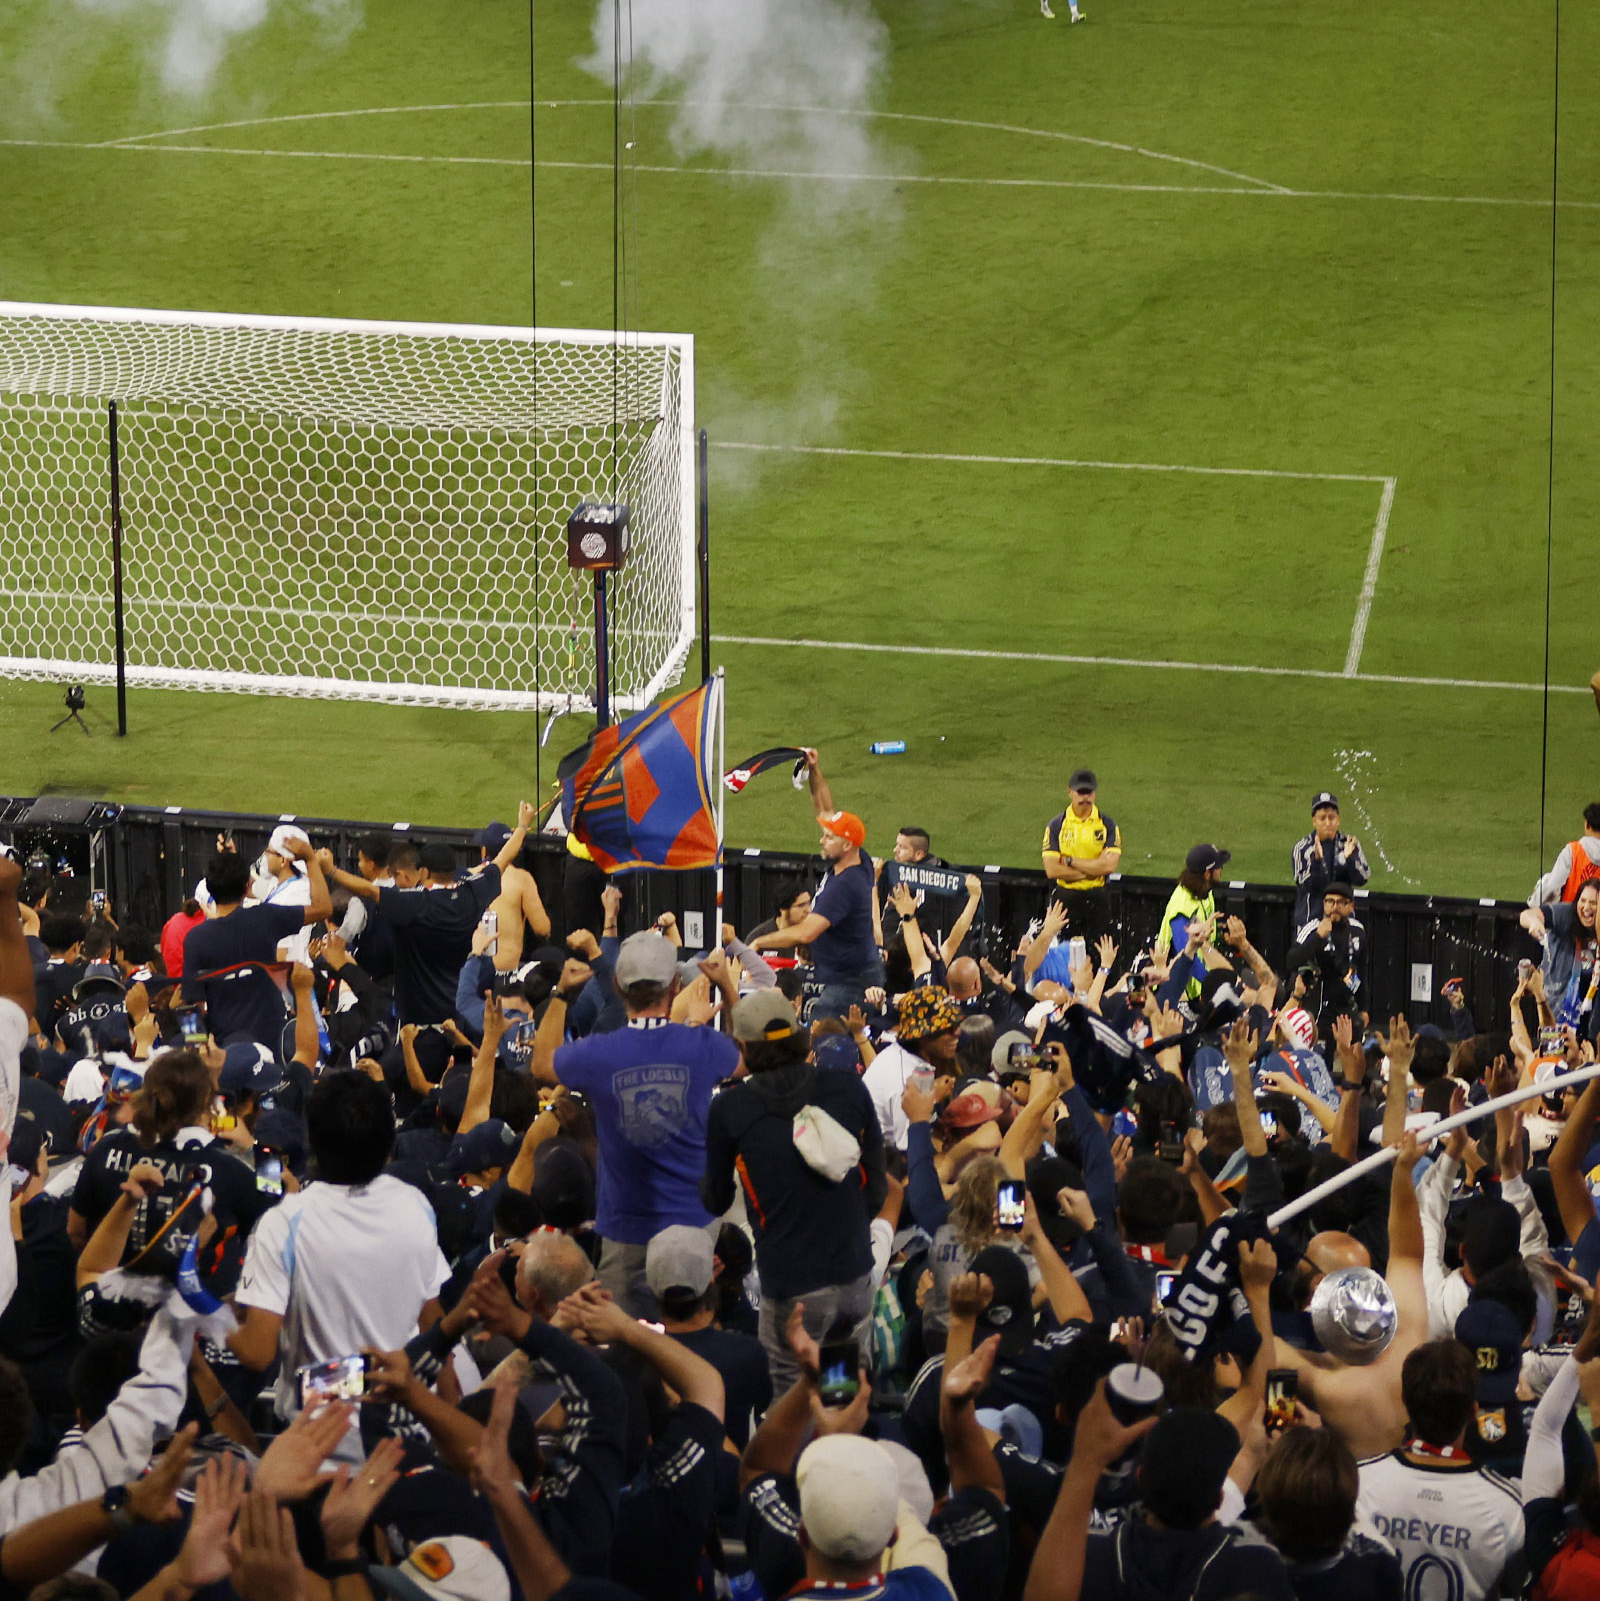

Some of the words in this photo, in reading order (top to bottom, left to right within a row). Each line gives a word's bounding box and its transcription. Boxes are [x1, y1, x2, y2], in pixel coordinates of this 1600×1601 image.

[898, 865, 918, 884] SAN
[919, 868, 946, 888] DIEGO
[946, 874, 960, 891] FC
[616, 1073, 640, 1089] THE
[641, 1068, 687, 1083] LOCALS
[1373, 1514, 1472, 1550] DREYER
[1397, 1552, 1465, 1601] 0
